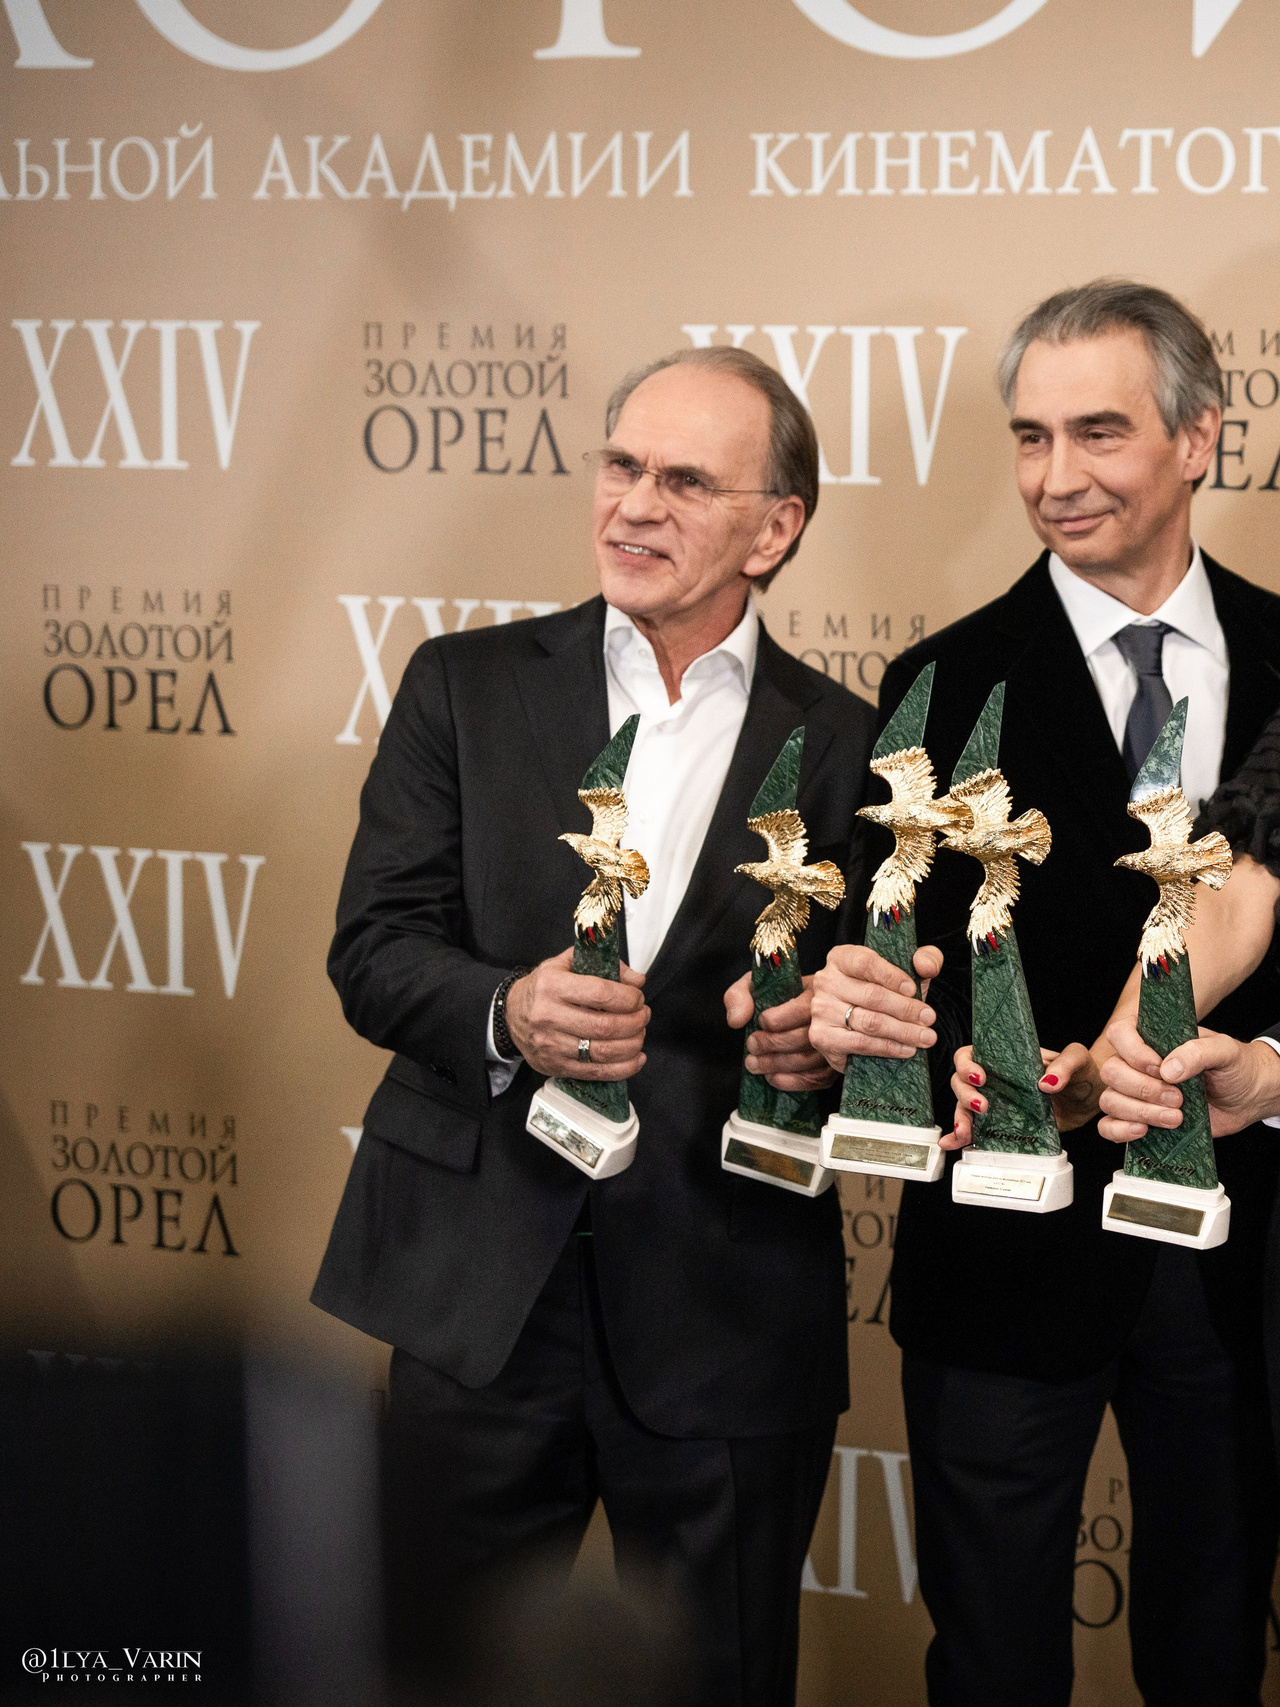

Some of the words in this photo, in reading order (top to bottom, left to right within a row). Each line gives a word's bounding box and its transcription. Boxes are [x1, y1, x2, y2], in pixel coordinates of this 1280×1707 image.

[0, 122, 218, 201] ЬНОЙ
[254, 131, 694, 210] АКАДЕМИИ
[362, 321, 567, 350] ПРЕМИЯ
[11, 319, 261, 470] XXIV
[364, 354, 569, 399] ЗОЛОТОЙ
[681, 324, 969, 486] XIV
[362, 404, 571, 476] ОРЕЛ
[42, 583, 231, 616] ПРЕМИЯ
[755, 608, 925, 641] ЕМИЯ
[43, 619, 233, 663] ЗОЛОТОЙ
[43, 663, 235, 736] ОРЕЛ
[20, 841, 267, 997] XXIV
[51, 1100, 236, 1140] ПРЕМИЯ
[52, 1134, 239, 1186] ЗОЛОТОЙ
[51, 1177, 240, 1257] ОРЕЛ
